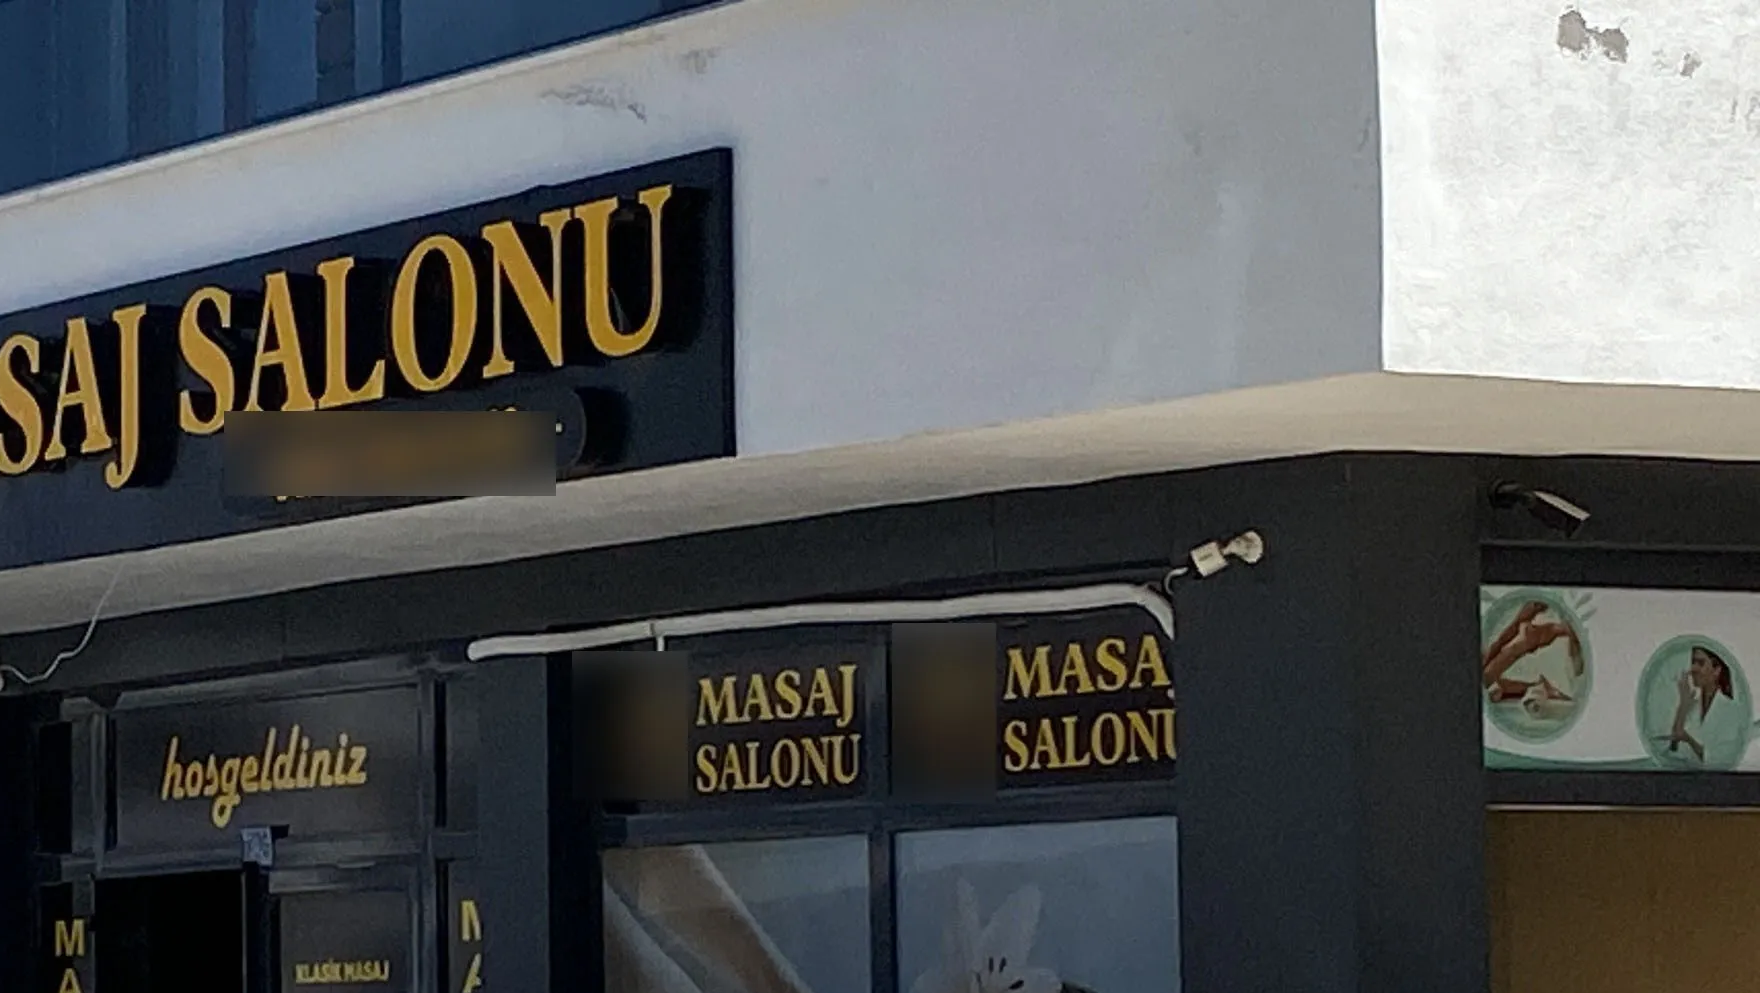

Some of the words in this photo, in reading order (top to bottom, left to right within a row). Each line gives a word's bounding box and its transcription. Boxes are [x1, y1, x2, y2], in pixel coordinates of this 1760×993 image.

[178, 185, 672, 435] SALONU
[696, 664, 857, 728] MASAJ
[1003, 634, 1175, 700] MASA
[696, 733, 862, 793] SALONU
